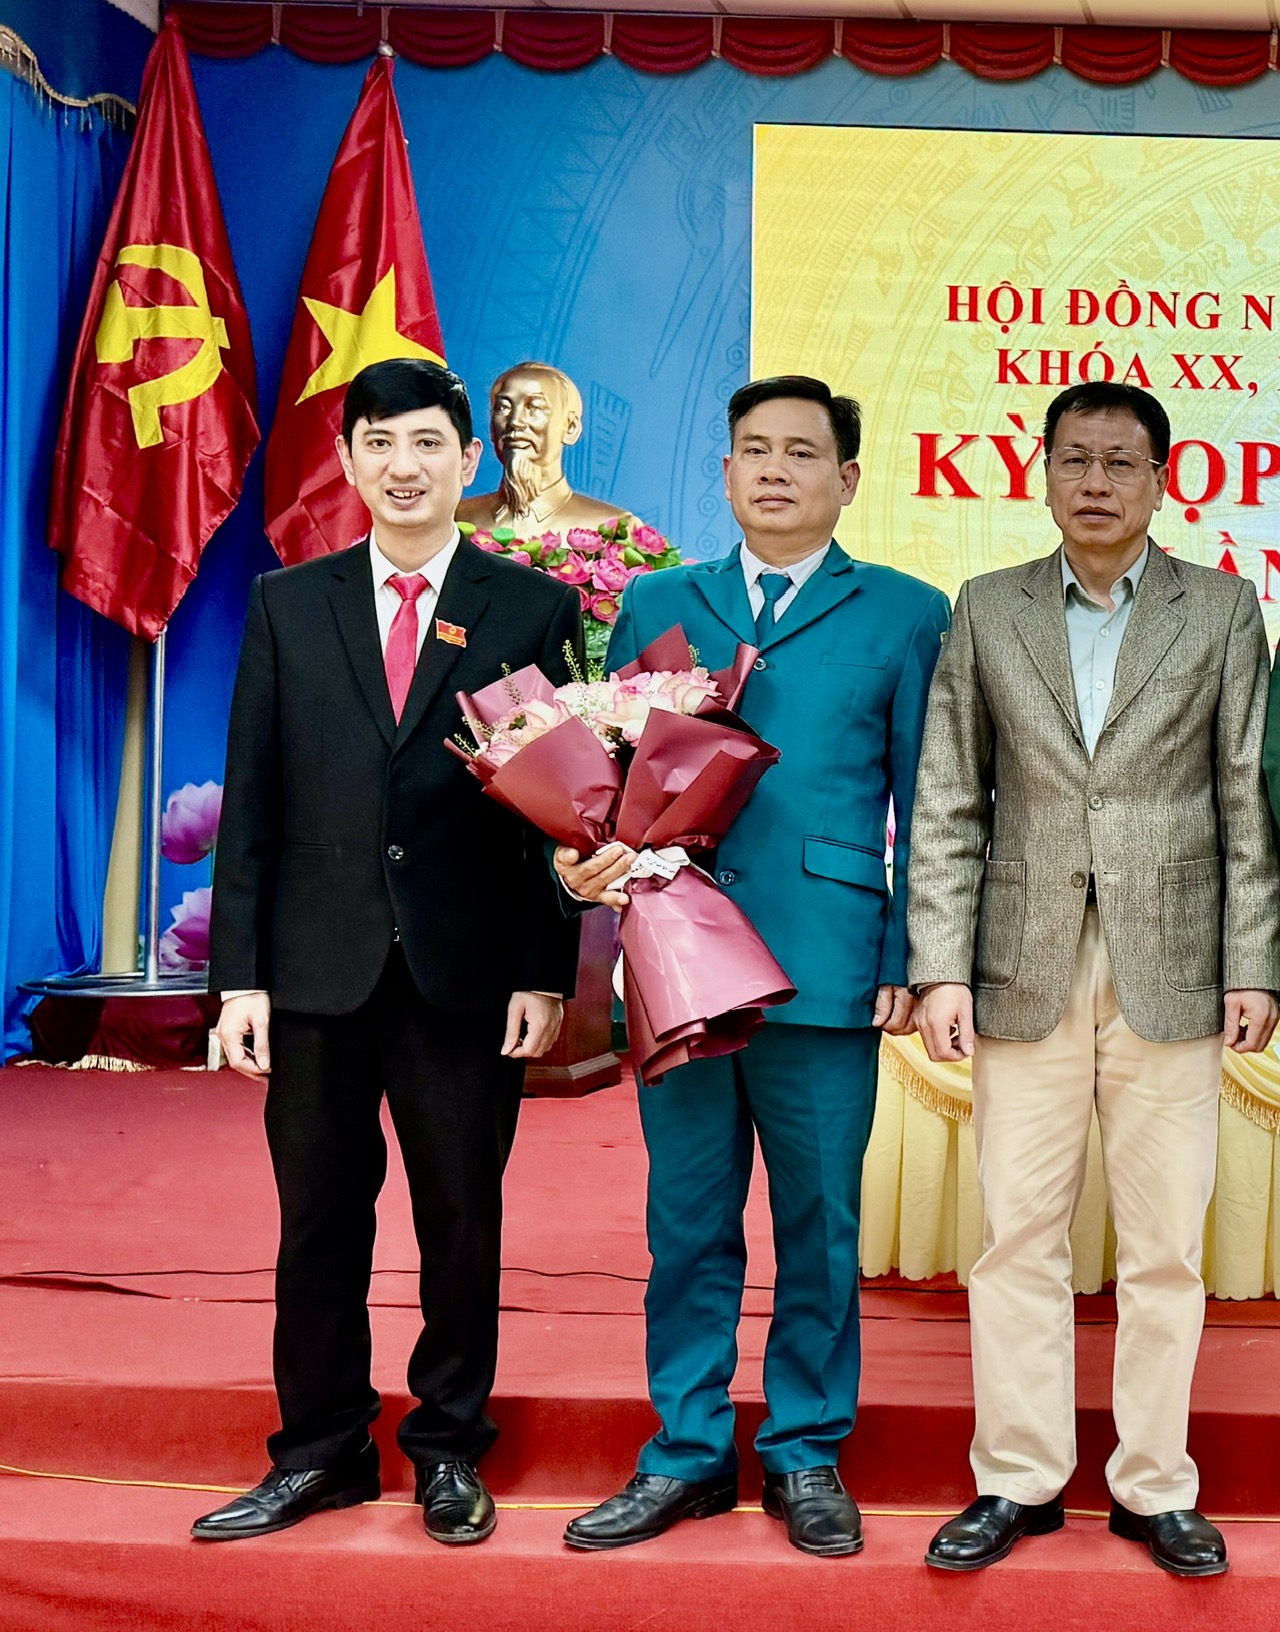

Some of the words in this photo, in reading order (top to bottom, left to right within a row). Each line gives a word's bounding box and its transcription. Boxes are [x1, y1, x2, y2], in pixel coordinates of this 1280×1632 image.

[945, 281, 1046, 334] HỘI
[1065, 279, 1221, 330] ĐỒNG
[995, 341, 1154, 389] KHÓA
[1170, 354, 1258, 398] XX,
[911, 412, 1044, 500] KỲ
